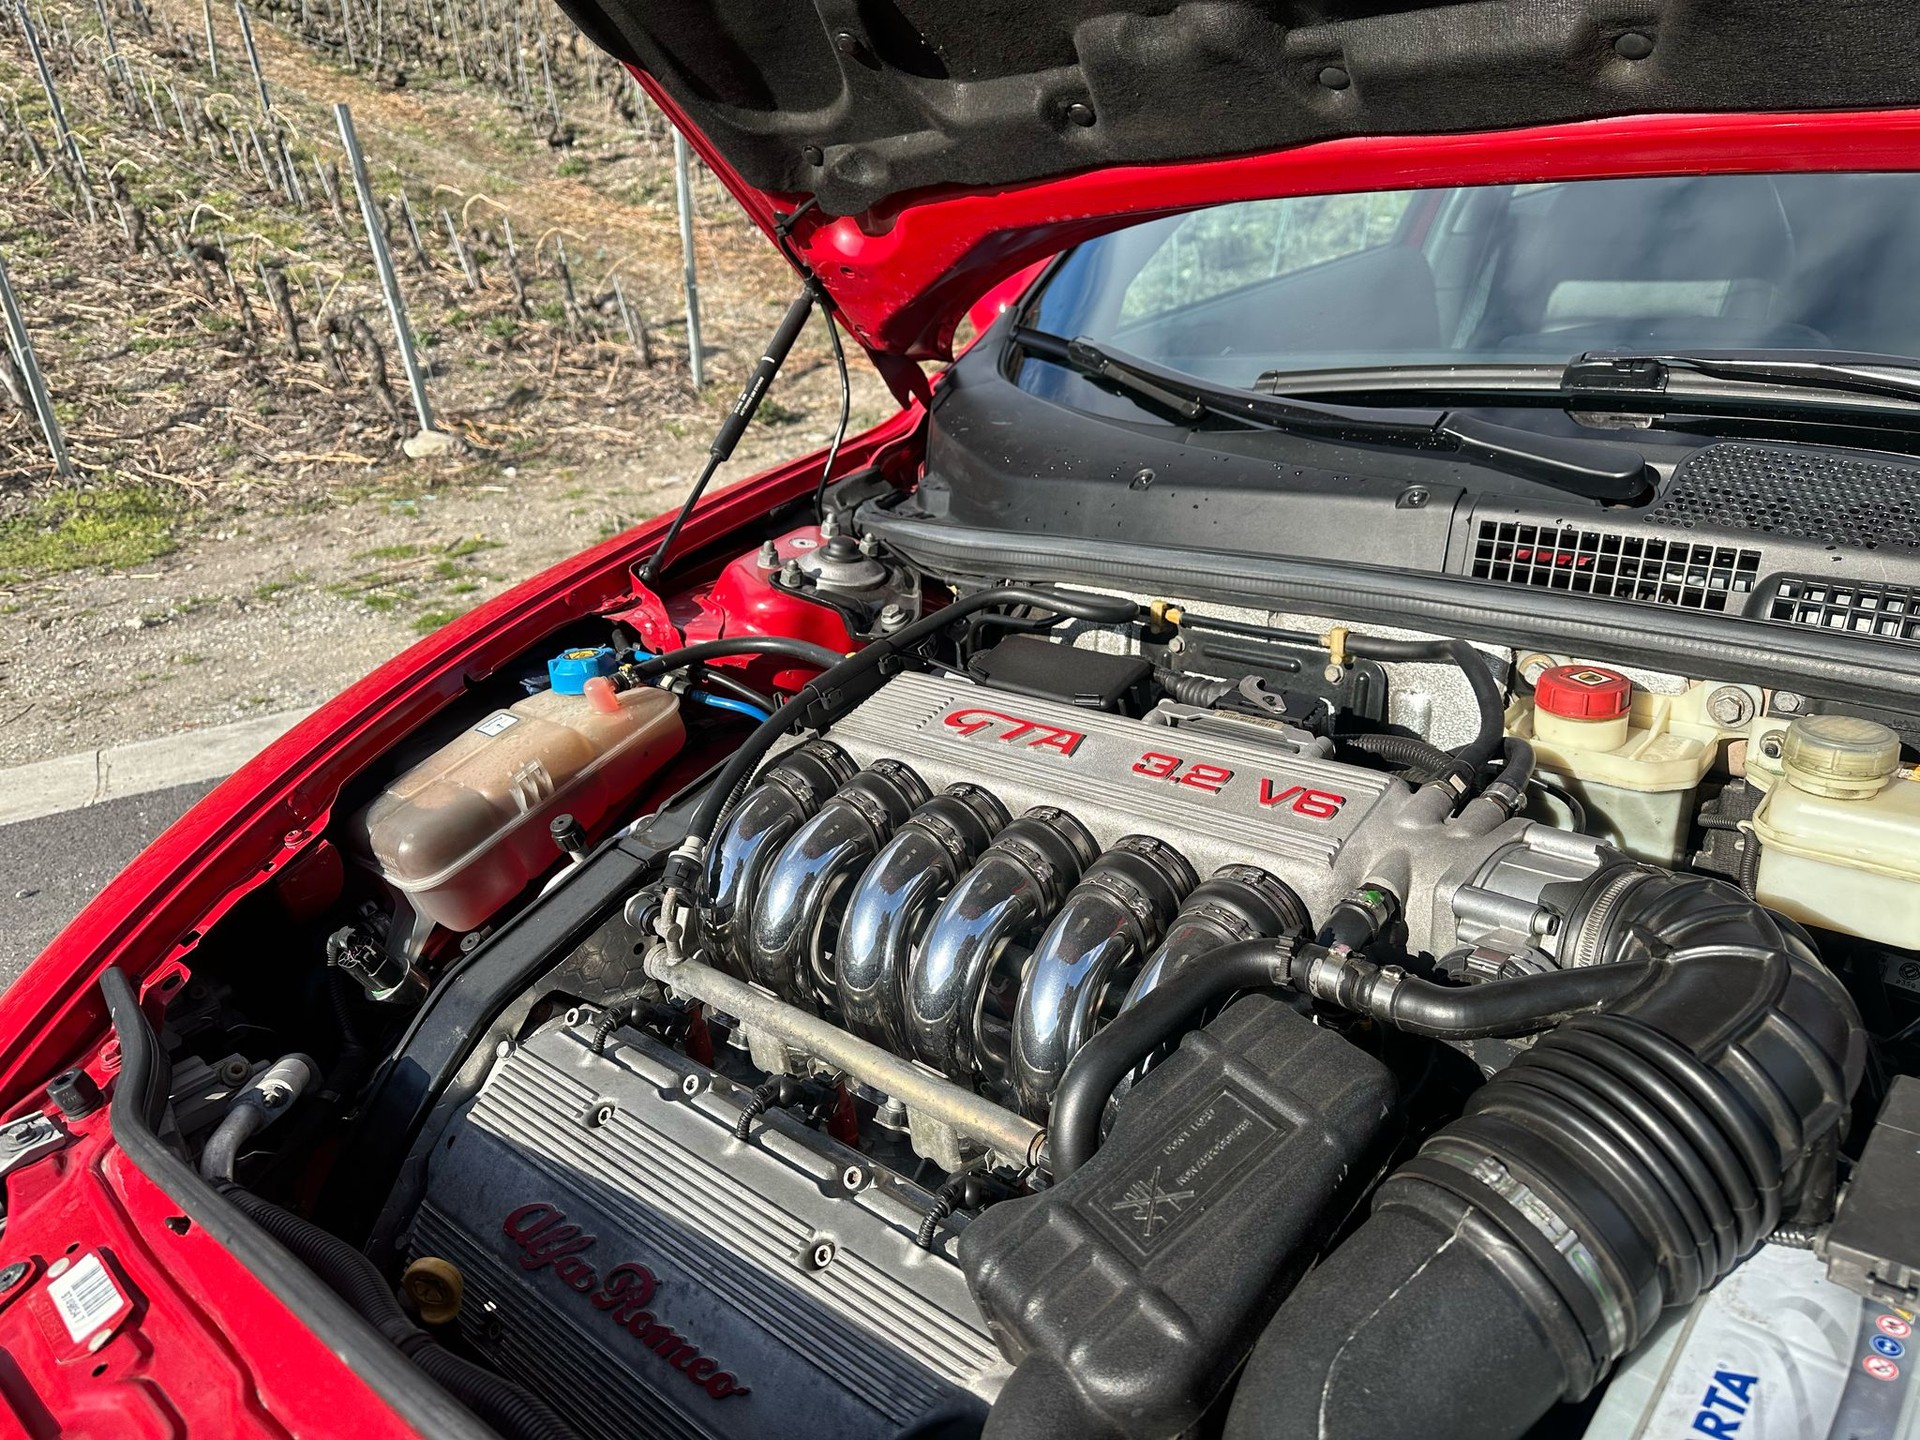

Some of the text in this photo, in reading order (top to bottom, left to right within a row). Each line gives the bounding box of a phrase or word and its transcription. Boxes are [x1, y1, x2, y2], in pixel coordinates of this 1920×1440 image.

[944, 709, 1346, 821] GTA 3.2 V6
[1176, 1165, 1199, 1187] NON
[502, 1202, 752, 1399] Alfa Romeo
[1684, 1370, 1759, 1440] RTA
